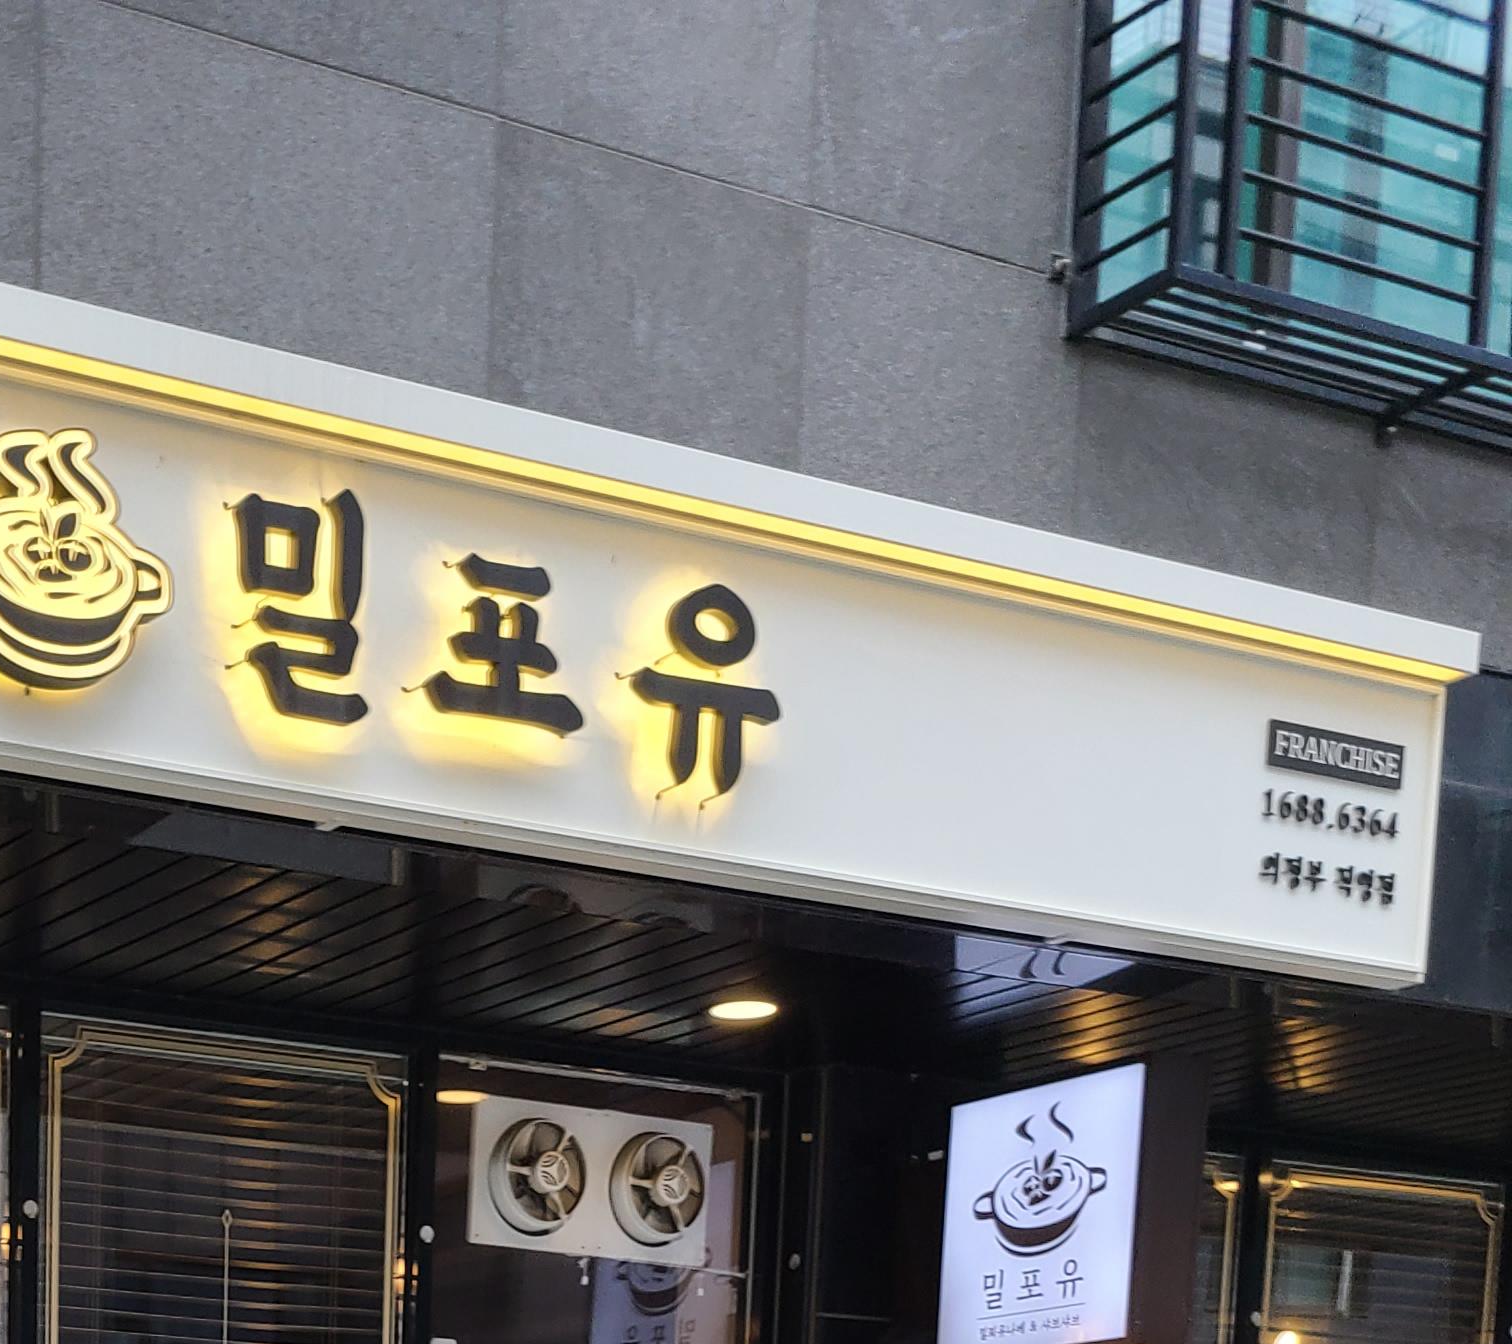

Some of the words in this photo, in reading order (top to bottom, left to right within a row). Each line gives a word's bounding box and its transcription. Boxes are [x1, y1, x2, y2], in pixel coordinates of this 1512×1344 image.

[233, 488, 781, 794] 밀포유
[1274, 730, 1400, 779] FRANCHISE
[984, 1259, 1084, 1310] 밀포유
